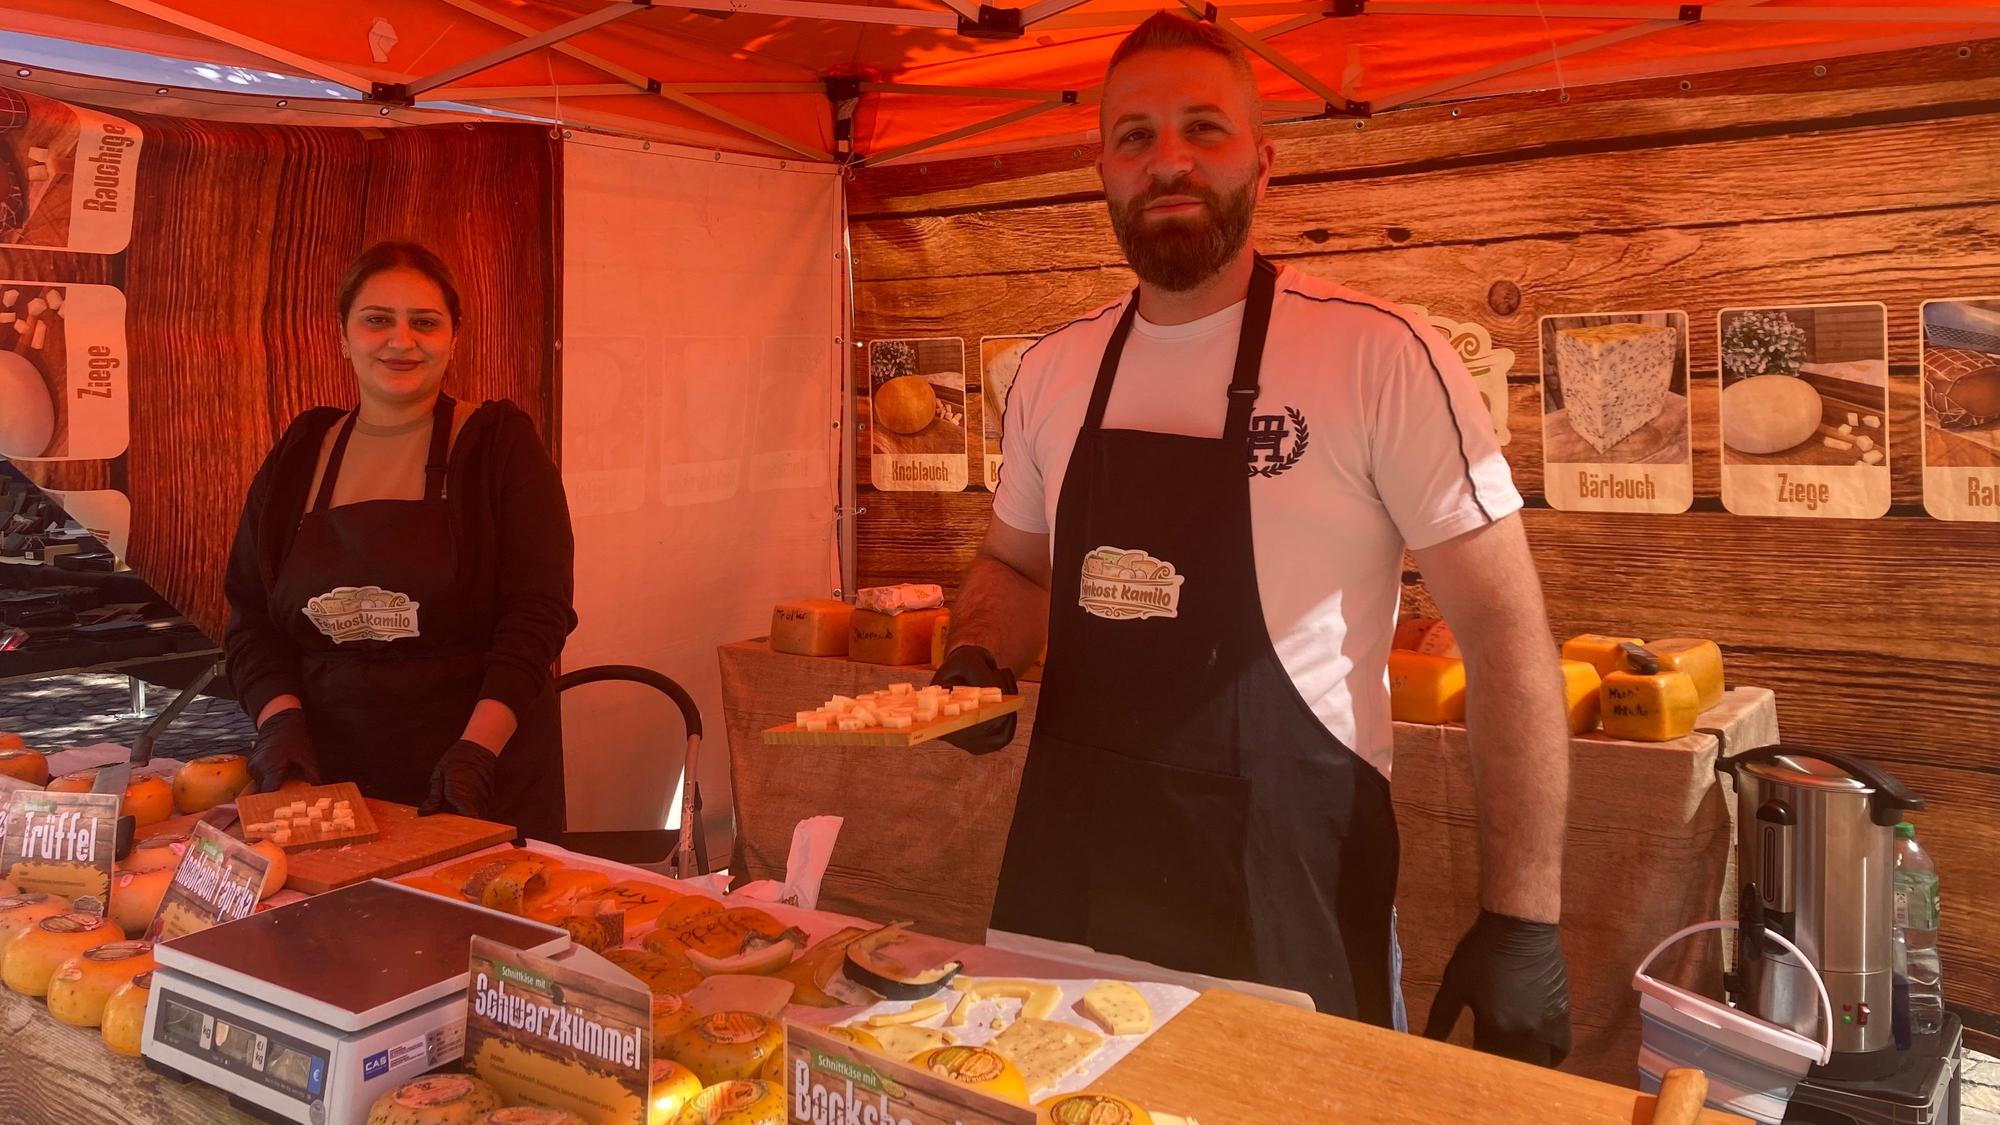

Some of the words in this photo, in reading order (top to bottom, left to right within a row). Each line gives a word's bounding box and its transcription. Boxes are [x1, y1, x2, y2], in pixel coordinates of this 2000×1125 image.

[83, 123, 135, 213] Rauchige
[77, 345, 120, 399] Ziege
[891, 461, 948, 482] Knoblauch
[1579, 471, 1656, 500] Bärlauch
[1777, 473, 1830, 511] Ziege
[1120, 584, 1172, 607] Kamilo
[21, 811, 98, 862] Trüffel
[212, 864, 254, 922] Paprika
[502, 965, 534, 986] Schnittkäse
[535, 978, 546, 990] mit
[202, 1025, 211, 1038] kg
[475, 972, 642, 1071] Schwarzkümmel
[255, 1053, 264, 1063] kg
[365, 1056, 387, 1072] CAS
[818, 1055, 862, 1082] Schnittkäse
[863, 1073, 876, 1087] mit
[313, 1069, 320, 1082] €
